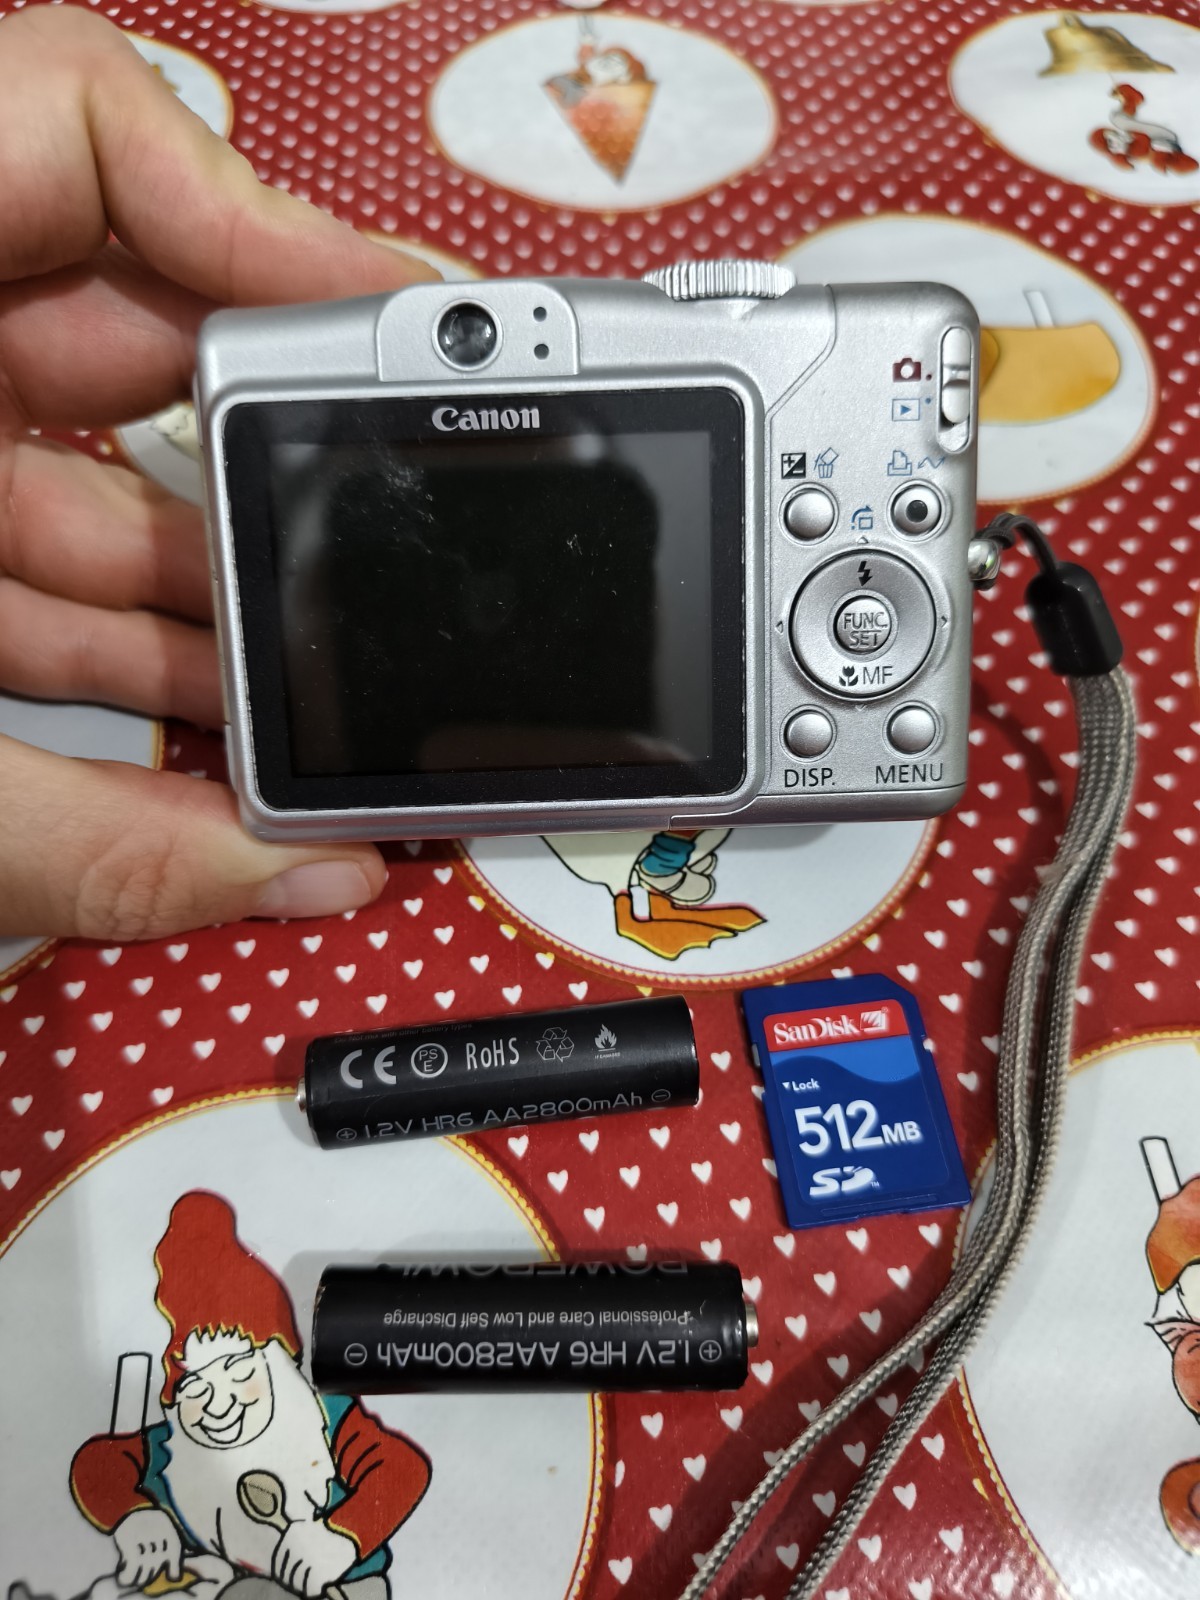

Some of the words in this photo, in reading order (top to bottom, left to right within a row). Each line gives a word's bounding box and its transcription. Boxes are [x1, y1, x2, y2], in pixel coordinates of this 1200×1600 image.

[432, 406, 540, 431] Canon
[850, 630, 880, 647] SET
[862, 665, 893, 685] MF
[784, 767, 836, 788] DISP.
[875, 763, 944, 784] MENU
[773, 1013, 861, 1045] SanDisk
[418, 1048, 439, 1061] PS
[466, 1037, 520, 1071] RoHS
[340, 1045, 397, 1089] CE
[792, 1078, 820, 1092] Lock
[364, 1118, 414, 1139] 1.2V
[422, 1111, 474, 1132] HR6
[483, 1091, 643, 1125] AA2800mAh
[383, 1308, 457, 1329] Discharge
[460, 1311, 489, 1328] Self
[493, 1311, 523, 1328] Low
[528, 1311, 555, 1328] and
[559, 1311, 595, 1327] Care
[600, 1310, 689, 1328] Professional
[377, 1341, 560, 1367] AA2800mAh
[569, 1340, 627, 1366] HR6
[636, 1339, 690, 1365] 1.2V
